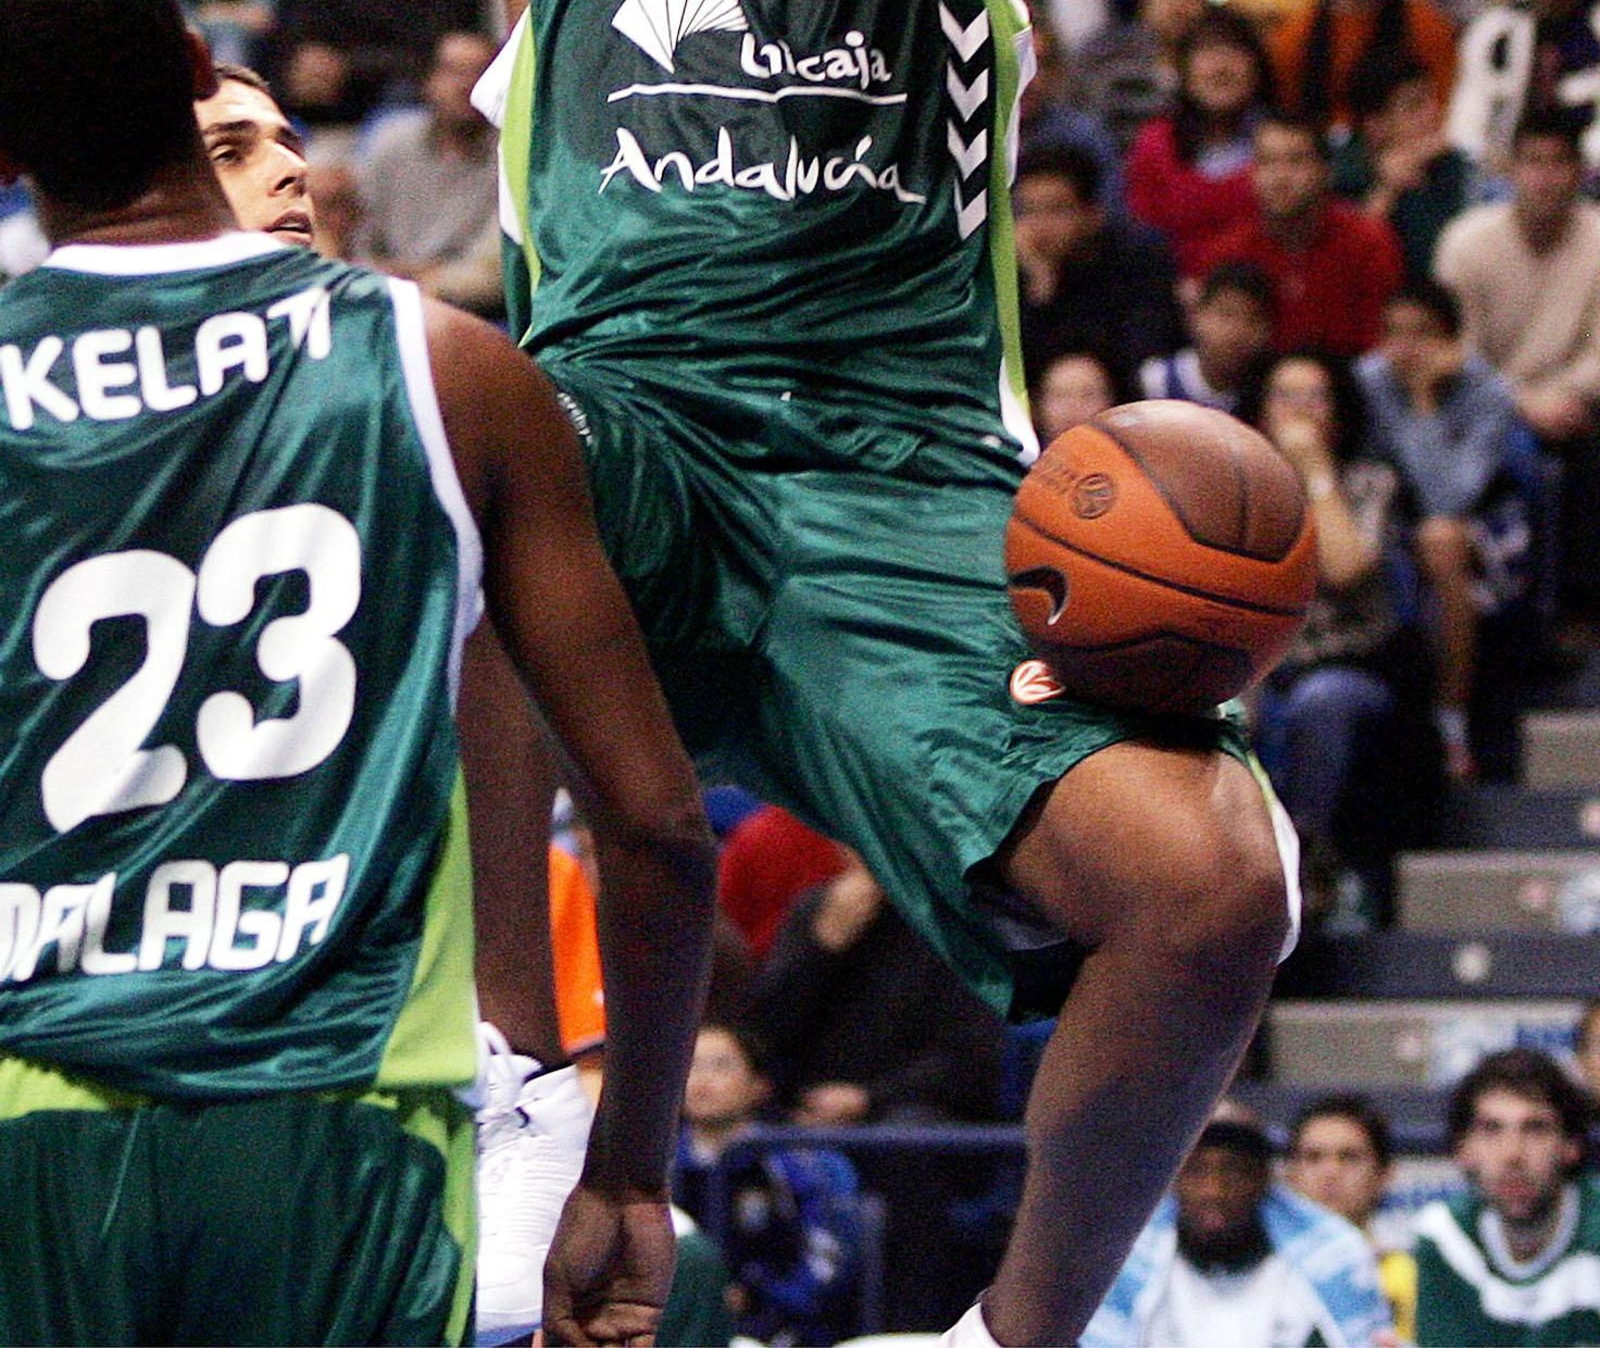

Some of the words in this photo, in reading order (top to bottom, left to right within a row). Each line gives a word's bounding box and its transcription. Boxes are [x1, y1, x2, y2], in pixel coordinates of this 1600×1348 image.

[741, 30, 892, 90] Unicaja
[599, 126, 926, 205] Andalucía
[33, 503, 361, 833] 23
